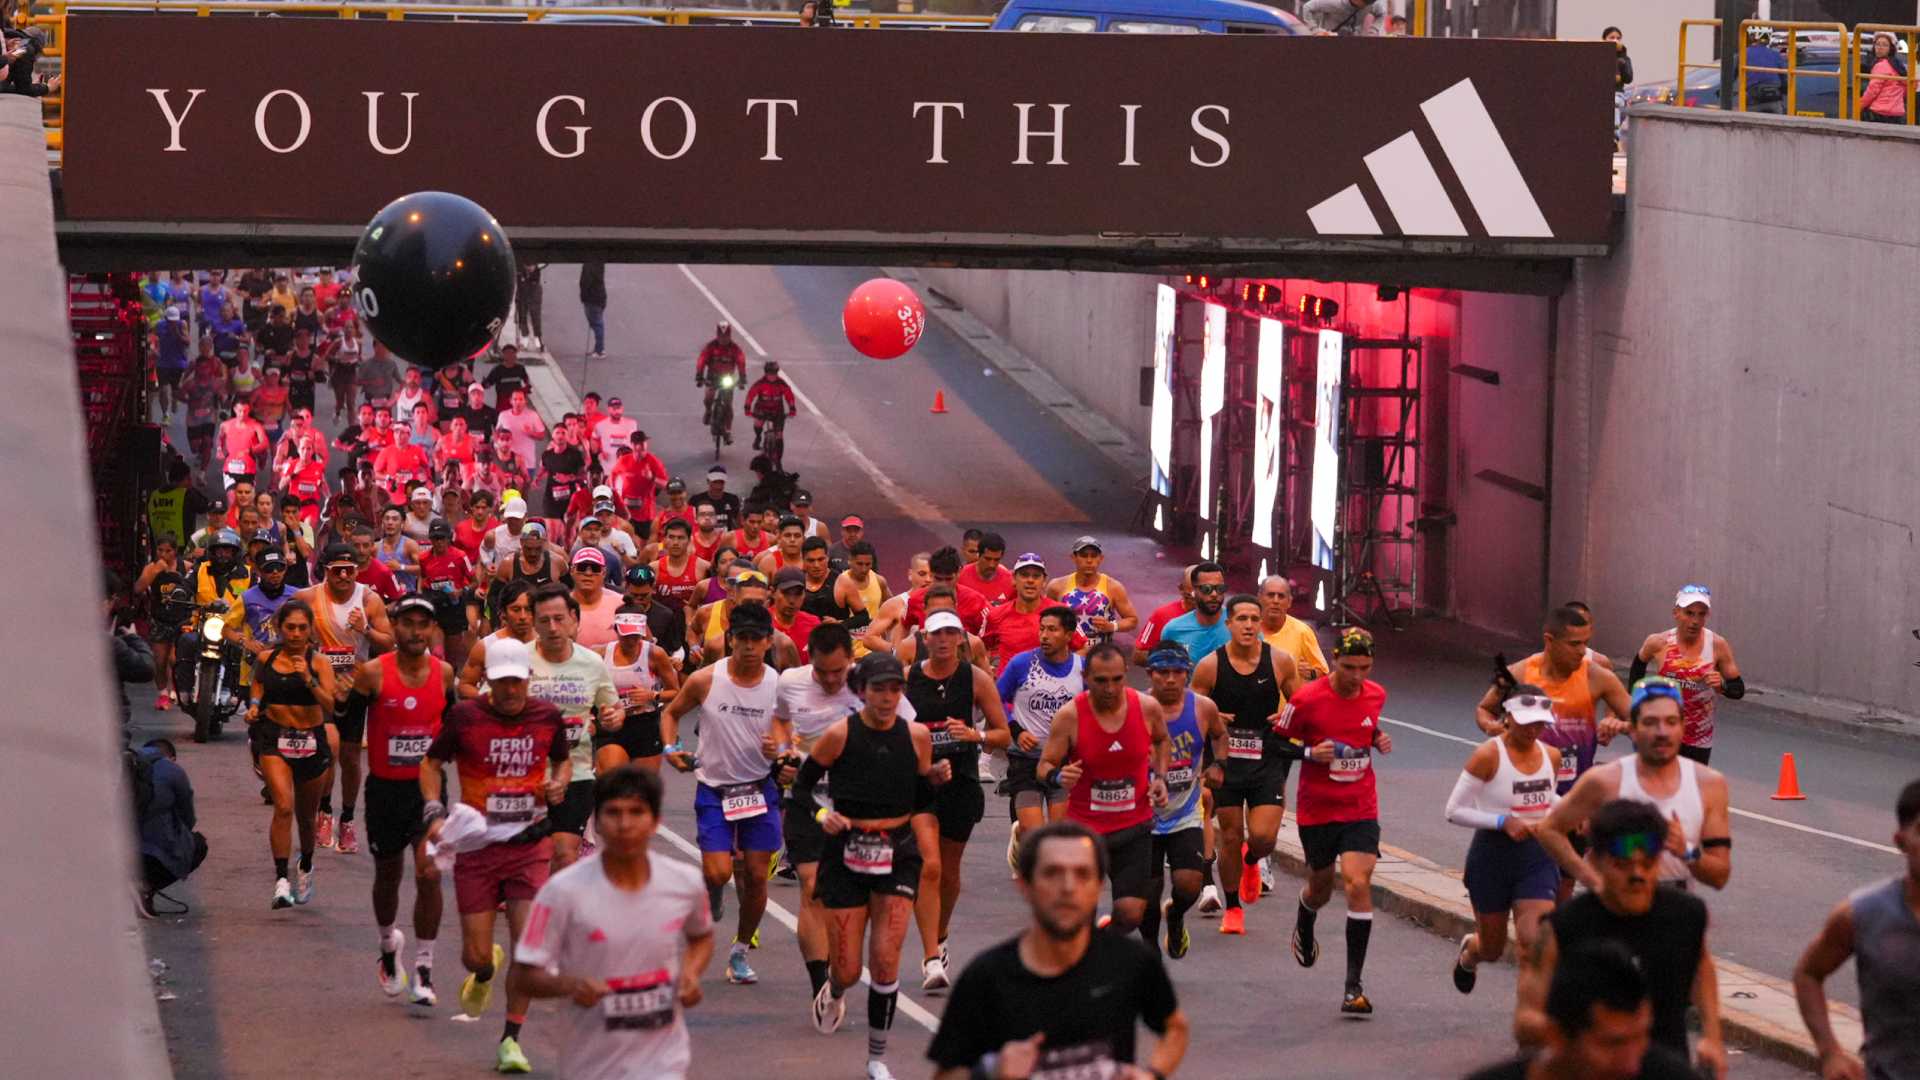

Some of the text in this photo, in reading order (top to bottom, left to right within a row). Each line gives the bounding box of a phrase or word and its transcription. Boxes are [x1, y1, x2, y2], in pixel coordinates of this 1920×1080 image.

[146, 88, 1231, 168] YOU GOT THIS
[897, 304, 917, 347] 3:20
[536, 693, 589, 705] ARATHON
[489, 734, 534, 752] PERÚ
[495, 764, 528, 778] LAB
[1340, 760, 1362, 770] 991
[1097, 790, 1129, 801] 4862
[1523, 792, 1546, 805] 530
[728, 796, 760, 809] 5078
